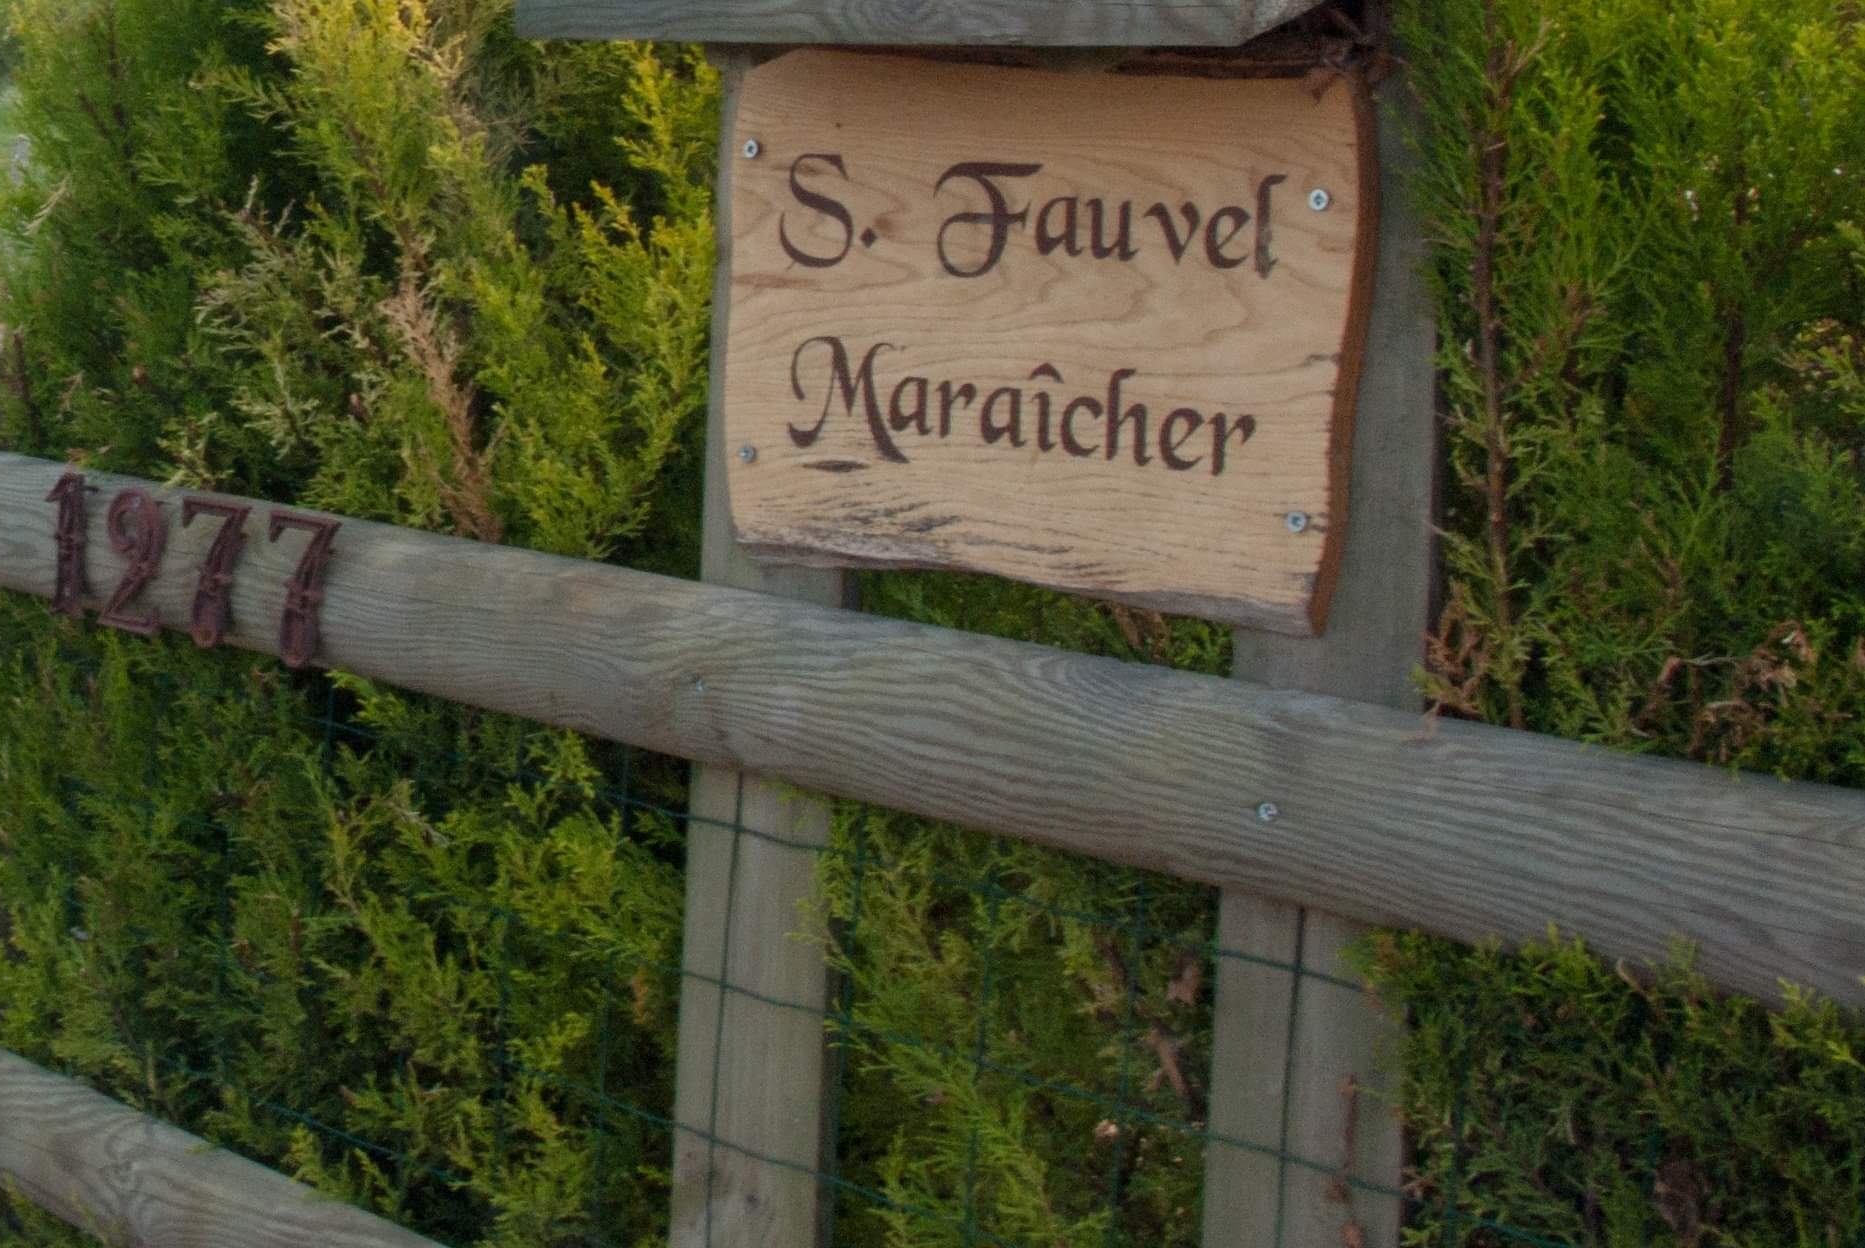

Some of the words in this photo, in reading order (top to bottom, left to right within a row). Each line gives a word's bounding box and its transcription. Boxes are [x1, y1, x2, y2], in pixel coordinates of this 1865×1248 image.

[780, 153, 877, 268] S.
[935, 162, 1288, 278] Fauvel
[787, 336, 1256, 475] Maraîcher
